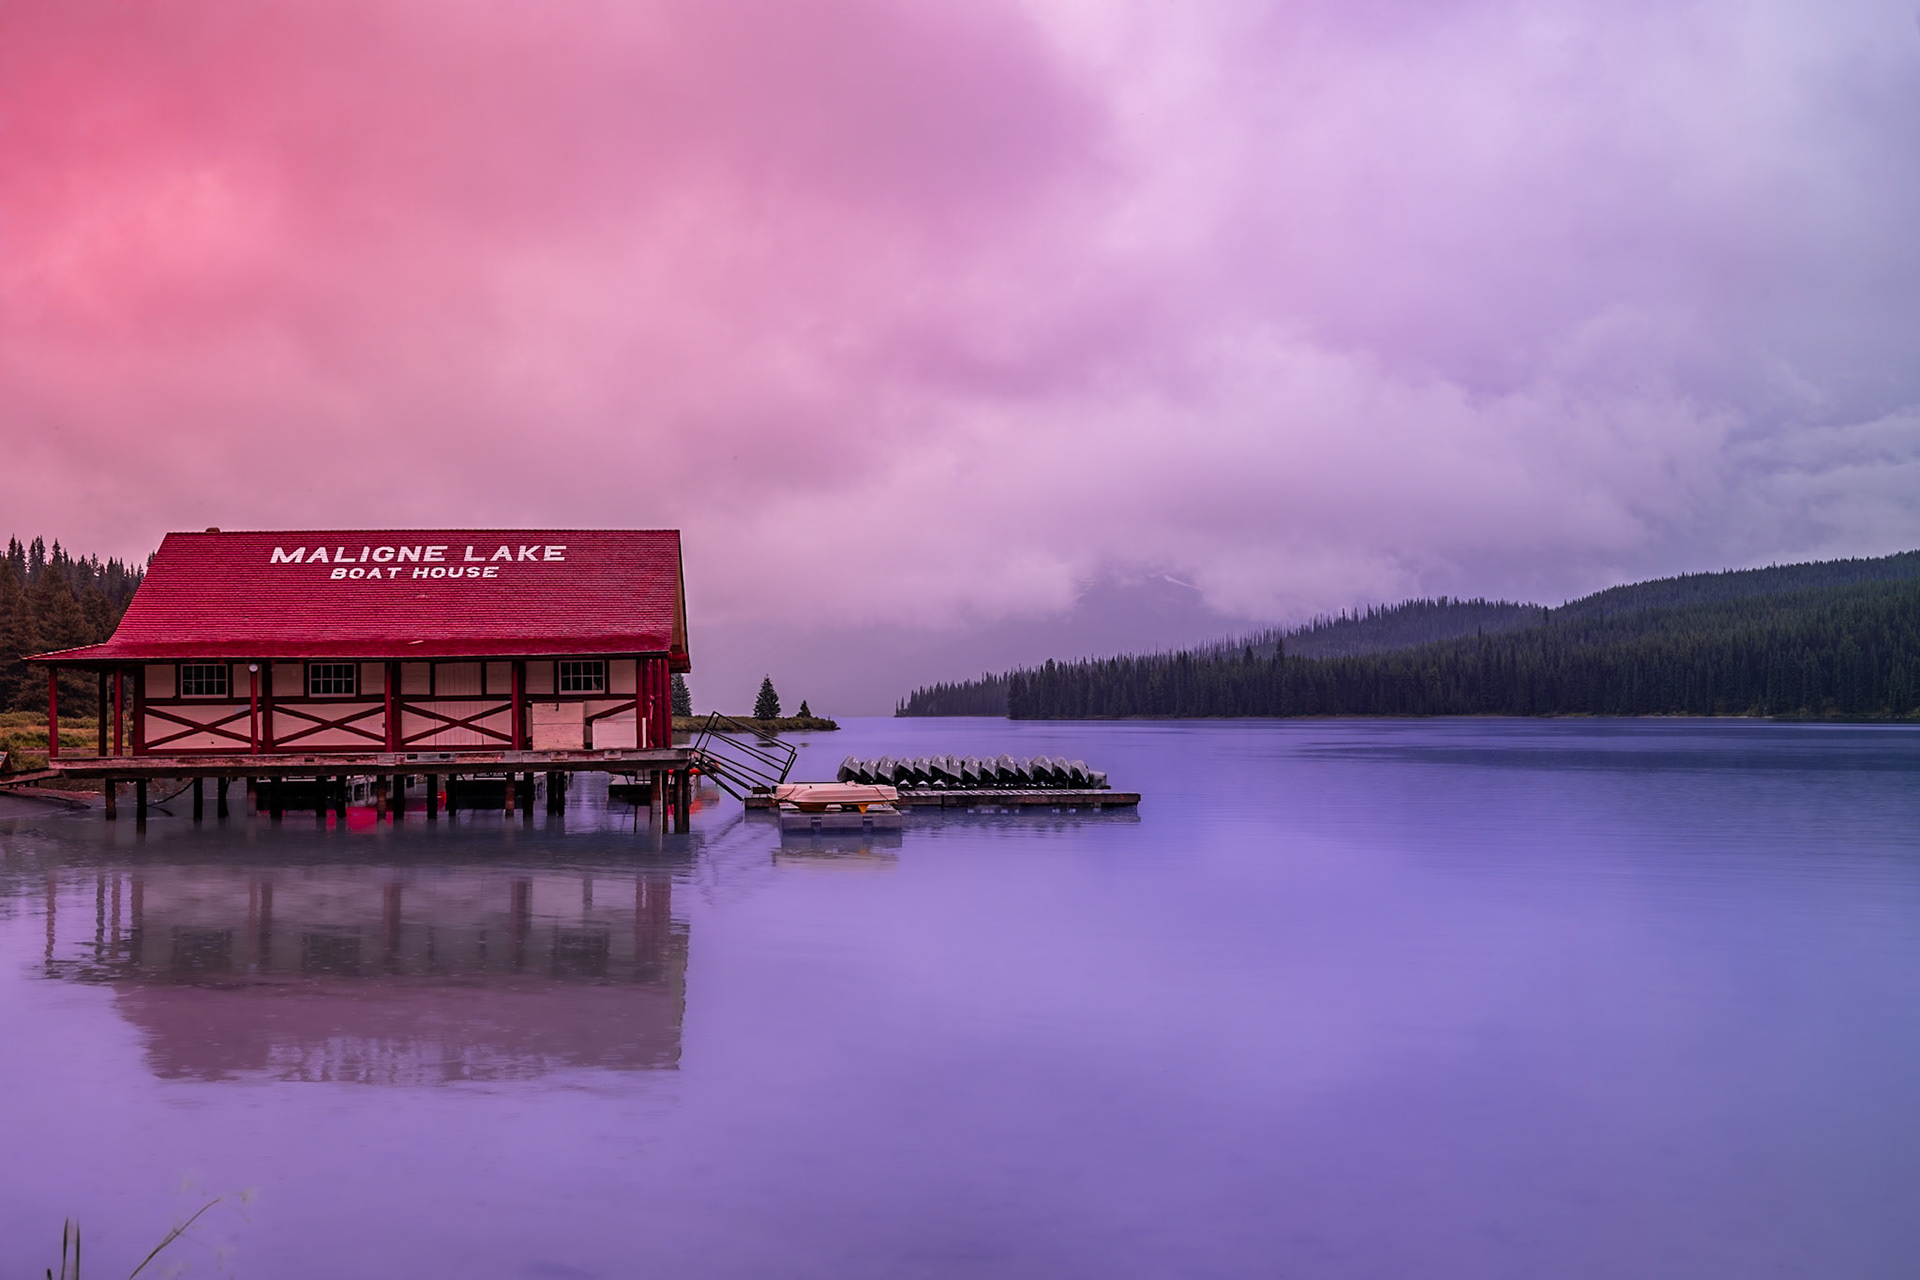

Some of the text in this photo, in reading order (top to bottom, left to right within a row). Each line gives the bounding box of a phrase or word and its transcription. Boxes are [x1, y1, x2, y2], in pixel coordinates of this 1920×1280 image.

[269, 545, 567, 564] MALIGNE LAKE
[330, 566, 500, 580] BOAT HOUSE
